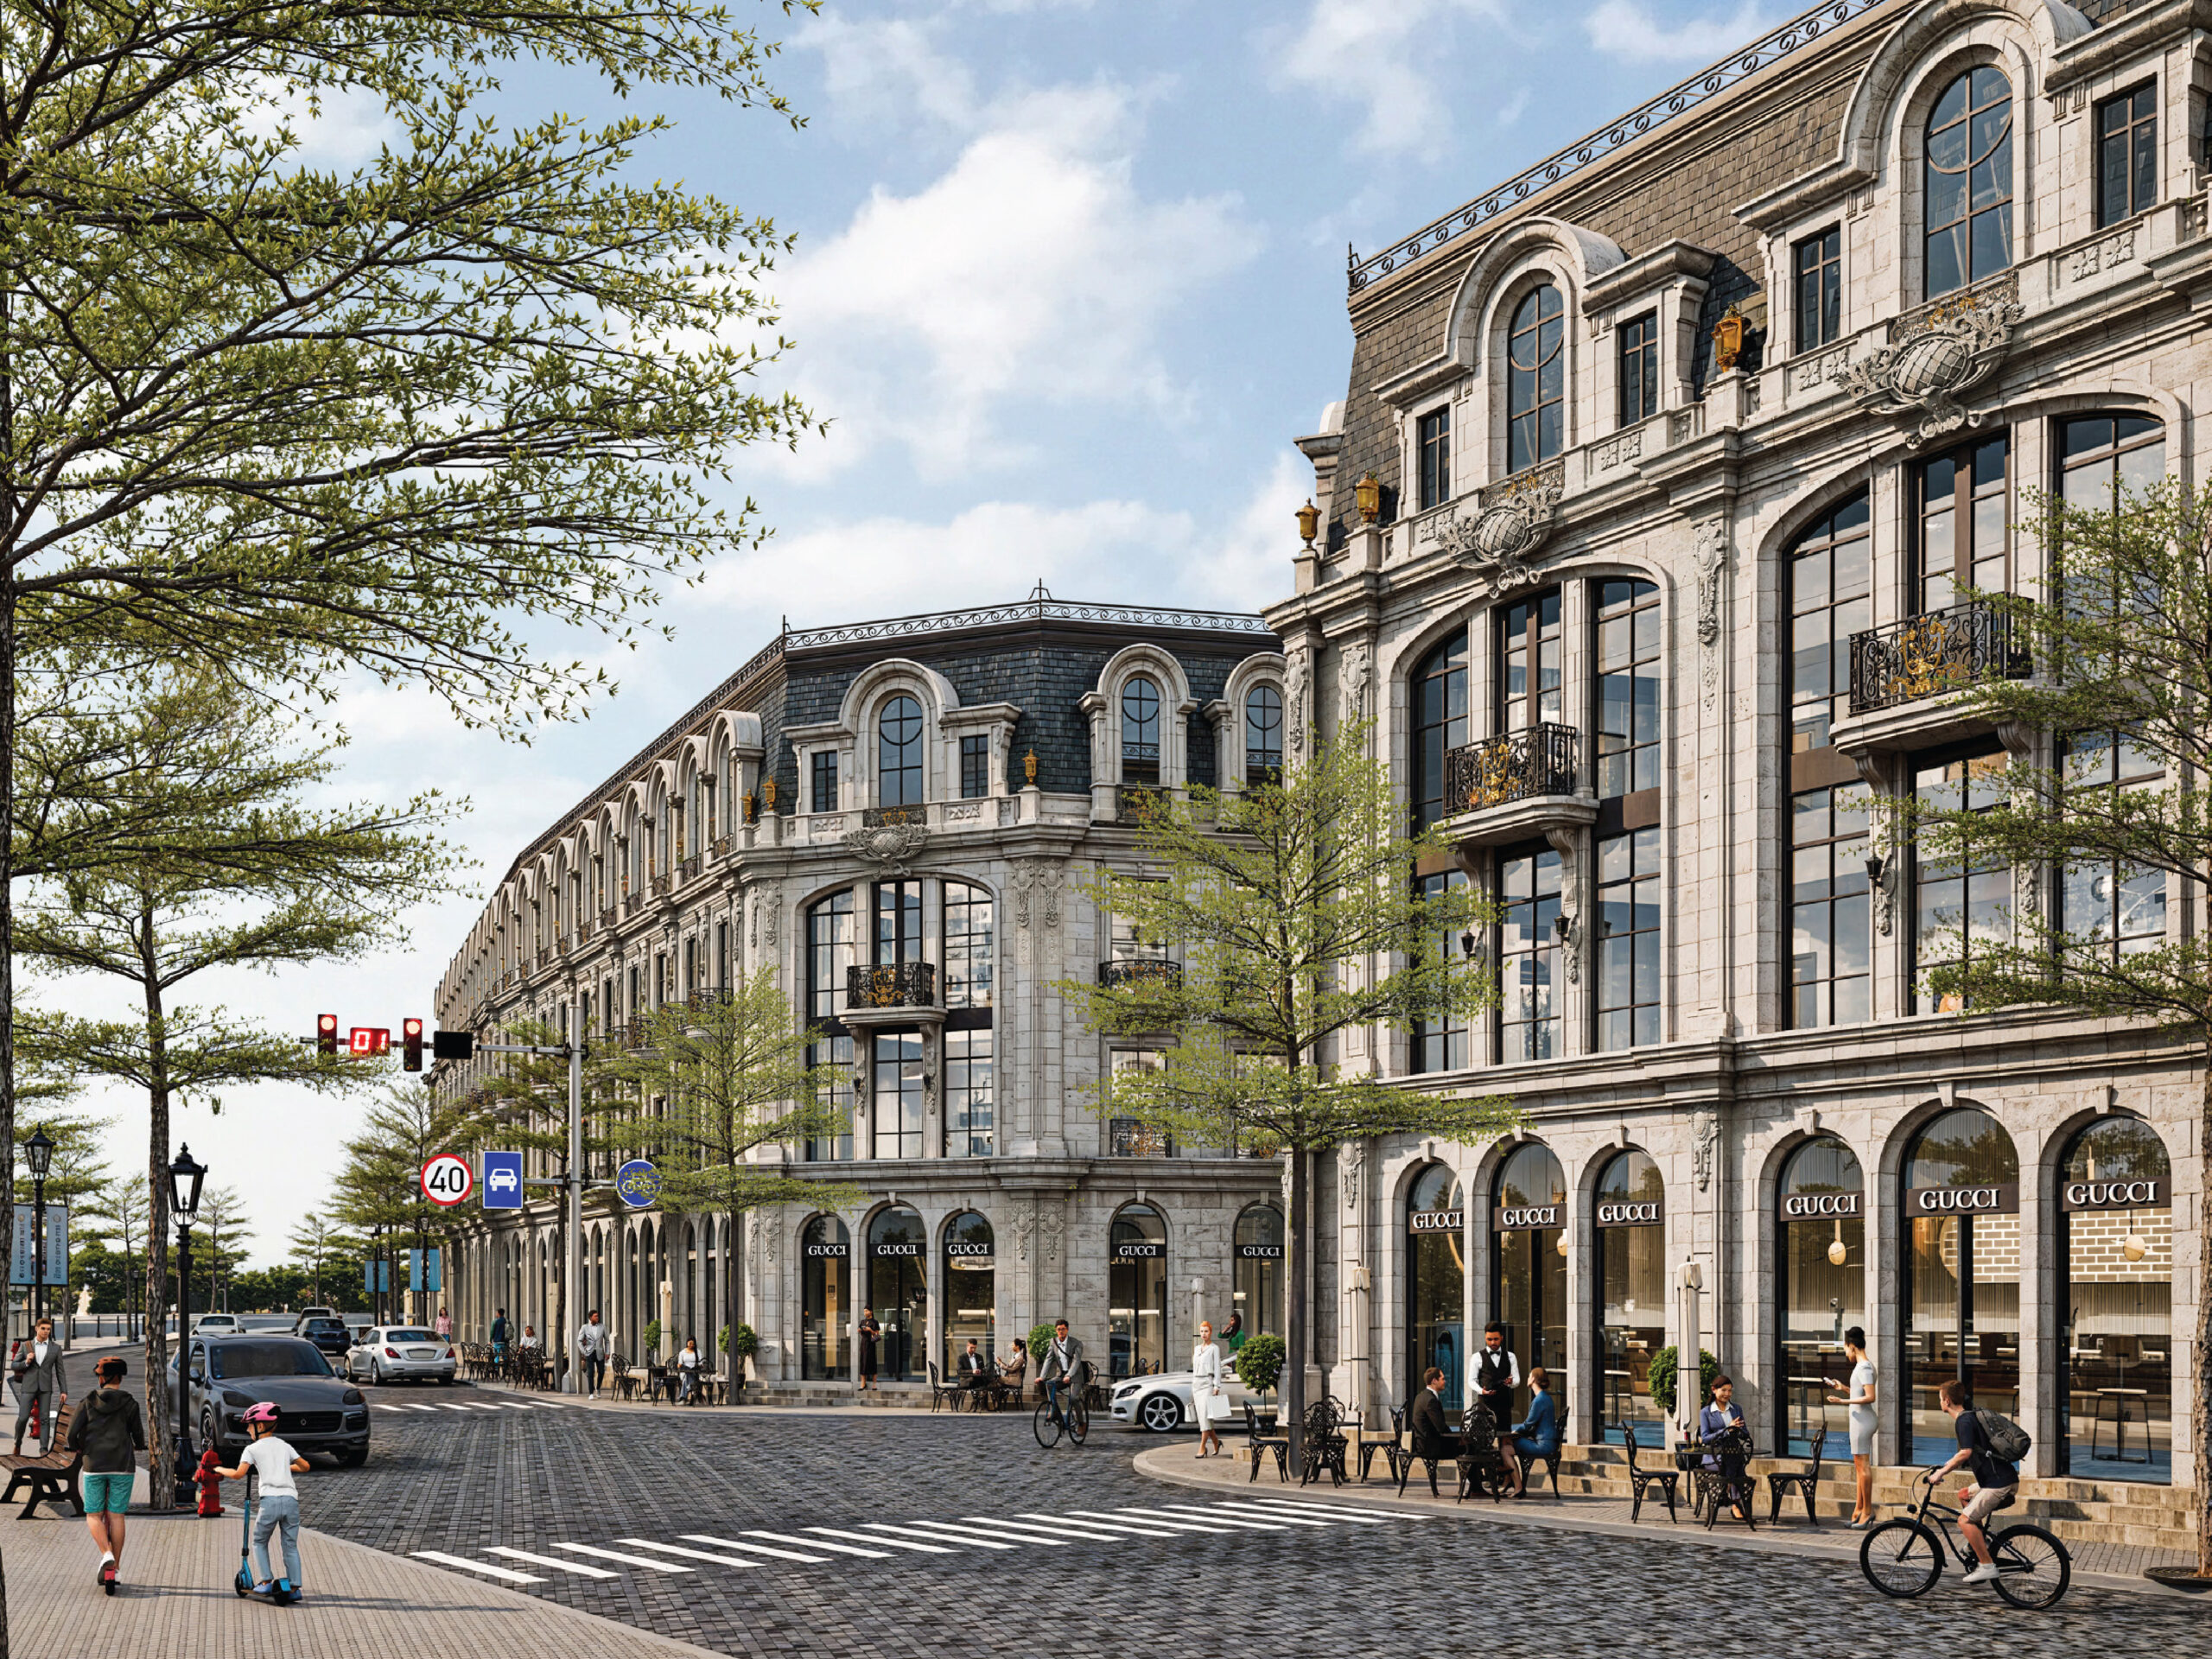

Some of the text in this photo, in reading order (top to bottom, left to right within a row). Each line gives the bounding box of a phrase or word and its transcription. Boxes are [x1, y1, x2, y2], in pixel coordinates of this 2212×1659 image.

[353, 1031, 388, 1051] 01
[429, 1165, 465, 1193] 40
[1919, 1189, 2000, 1210] GUCCI
[2067, 1181, 2157, 1205] GUCCI
[1599, 1204, 1659, 1222] GUCCI
[1785, 1194, 1859, 1216] GUCCI
[1503, 1208, 1557, 1225] GUCCI
[808, 1245, 847, 1255] GUCCI
[948, 1243, 988, 1255] GUCCI
[1119, 1245, 1157, 1255] GUCCI
[1243, 1246, 1281, 1257] GUCCI
